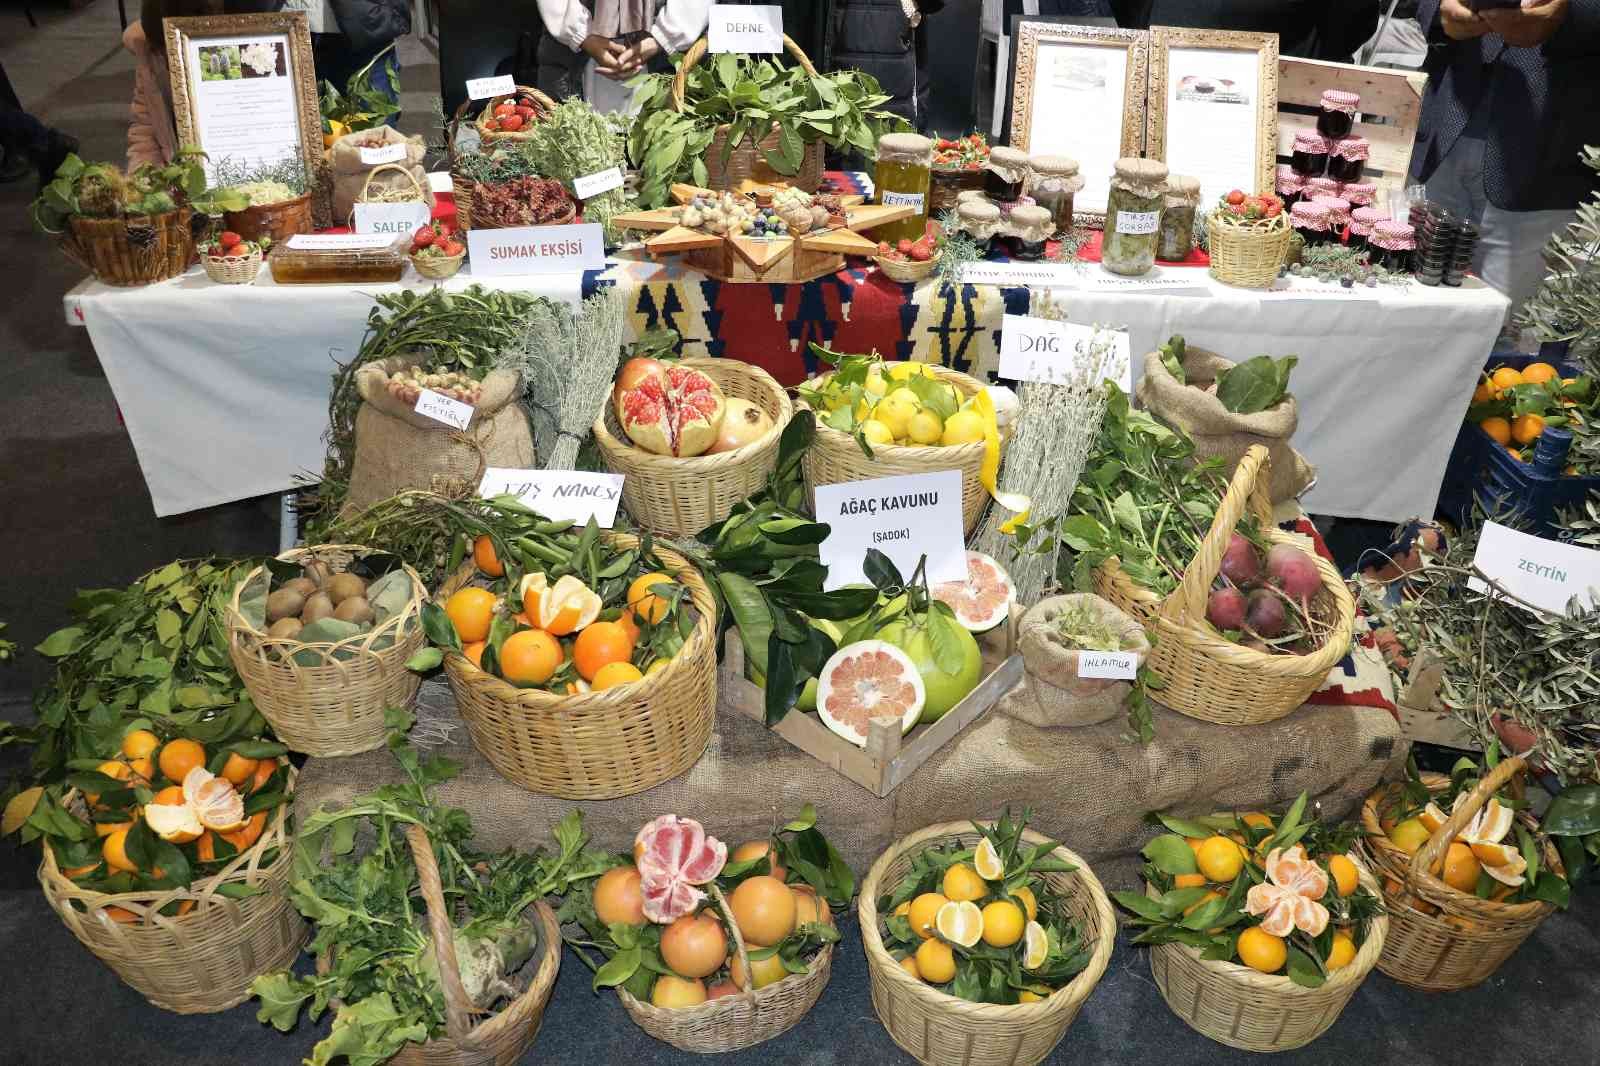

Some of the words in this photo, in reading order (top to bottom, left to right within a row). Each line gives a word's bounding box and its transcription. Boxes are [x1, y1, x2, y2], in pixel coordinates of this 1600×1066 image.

[726, 22, 765, 33] DEFNE
[373, 221, 413, 233] SALEP
[490, 244, 537, 260] SUMAK
[540, 239, 583, 259] EKŞİSİ
[839, 496, 878, 516] AĞAÇ
[881, 491, 939, 511] KAVUNU
[872, 527, 911, 544] (ŞADOK)
[1517, 558, 1568, 582] ZEYTİN
